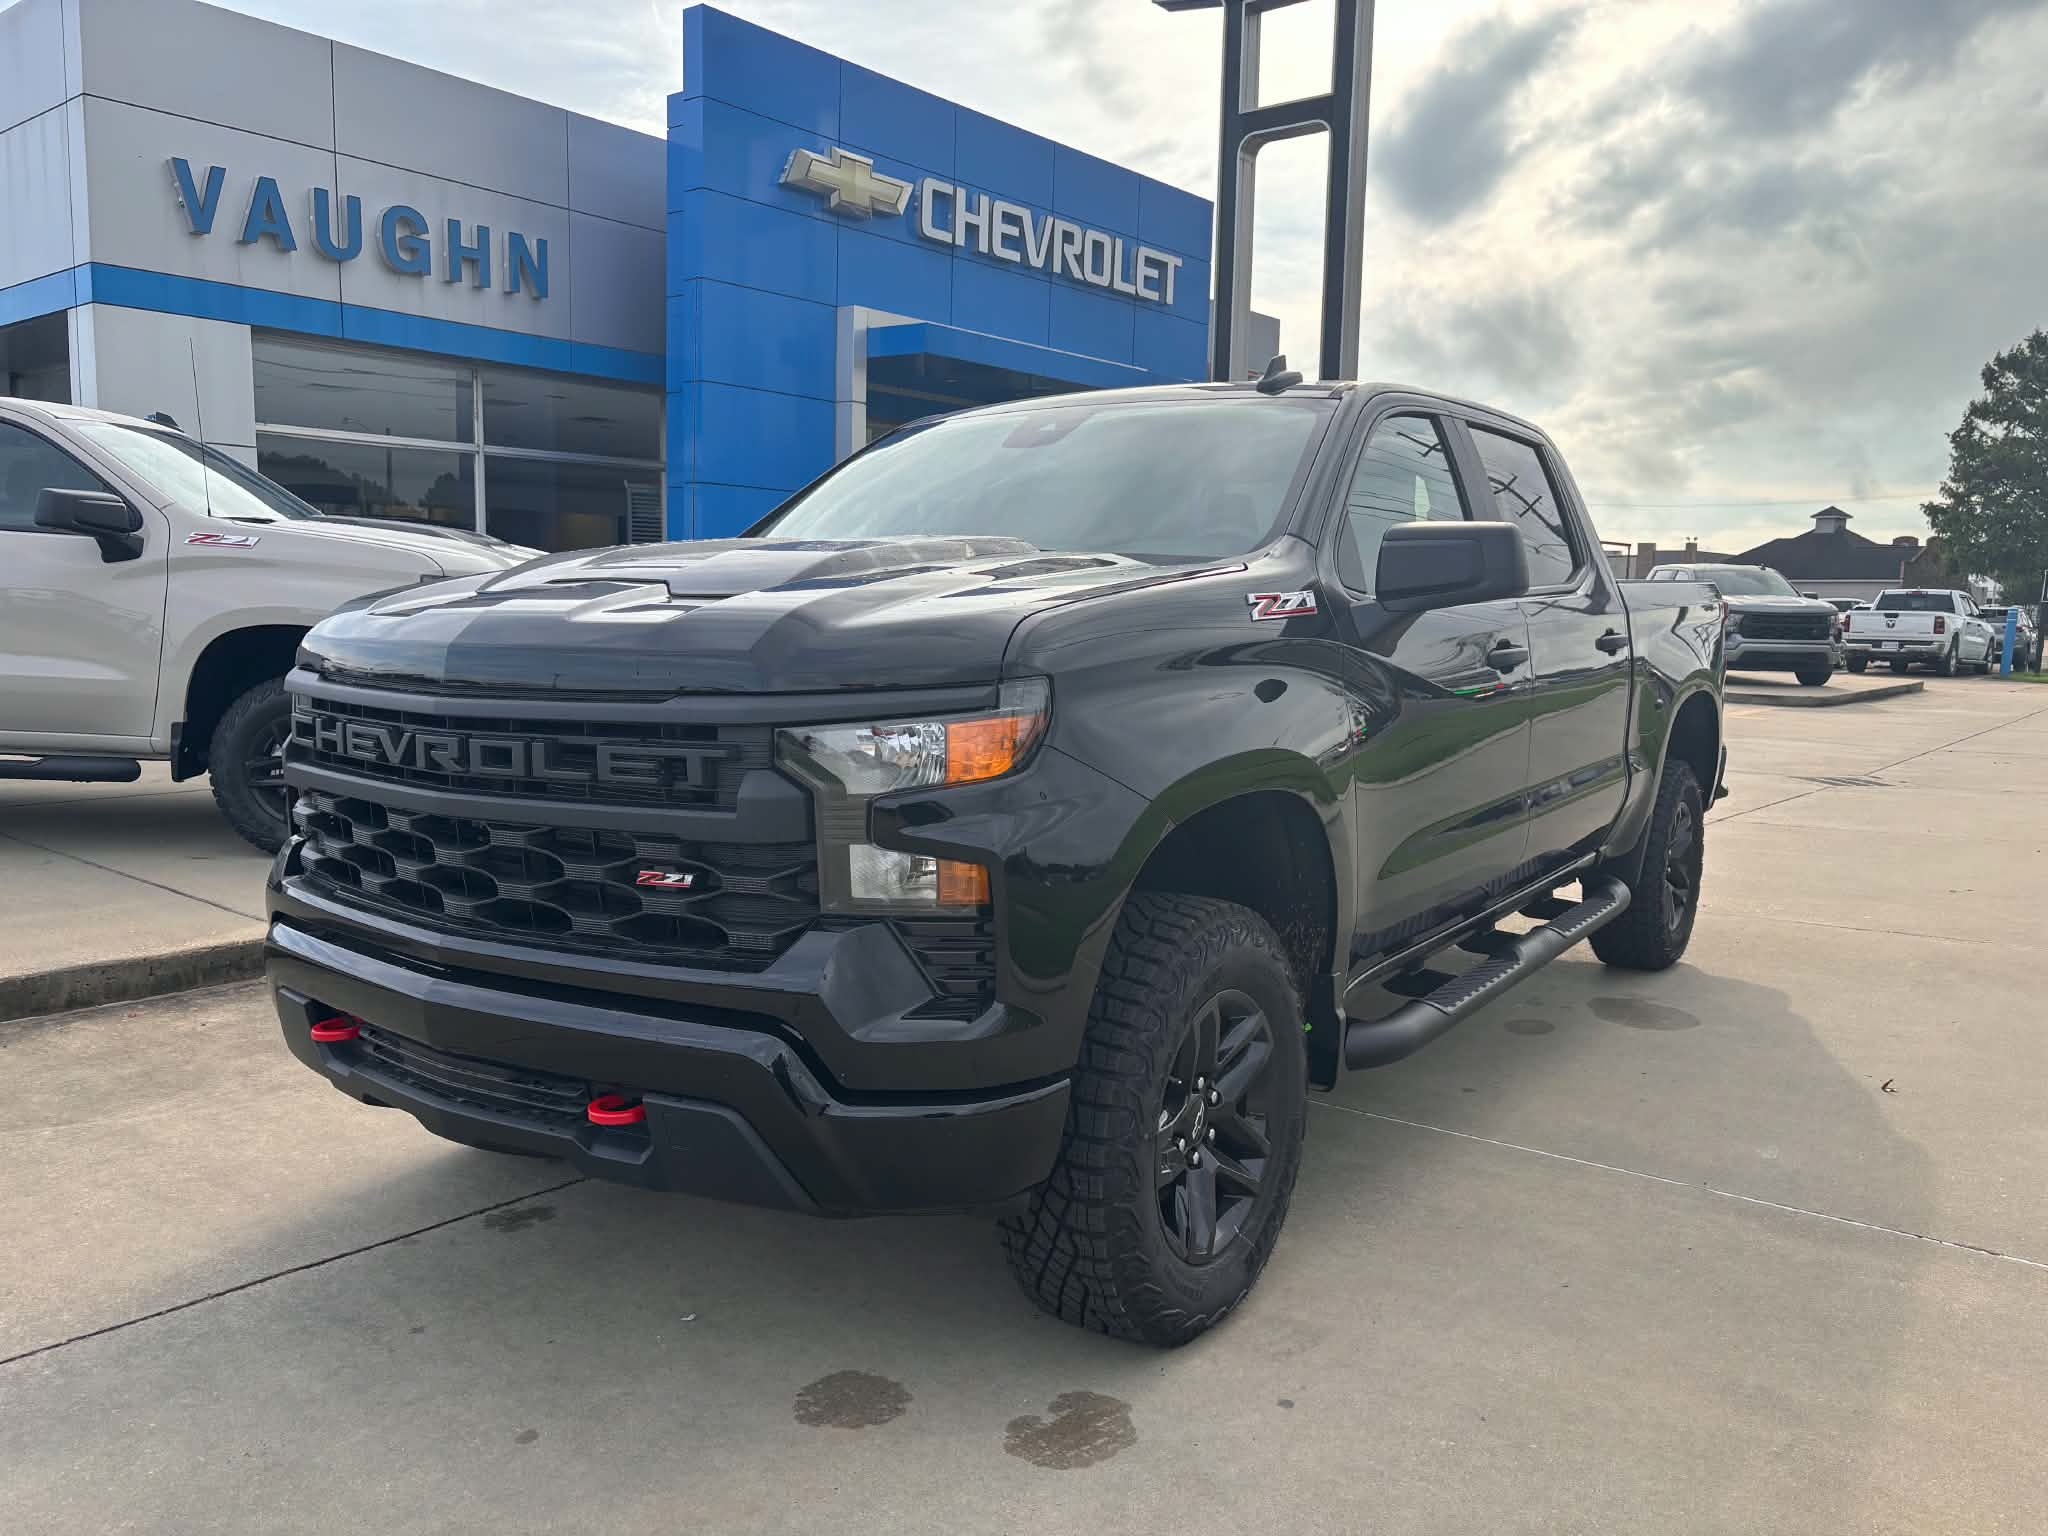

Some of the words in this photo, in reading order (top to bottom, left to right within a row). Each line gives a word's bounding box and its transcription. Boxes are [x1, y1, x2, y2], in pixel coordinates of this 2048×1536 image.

[167, 156, 549, 300] VAUGHN
[920, 177, 1183, 305] CHEVROLET
[1246, 590, 1318, 622] Z71
[291, 712, 729, 786] CHEVROLET
